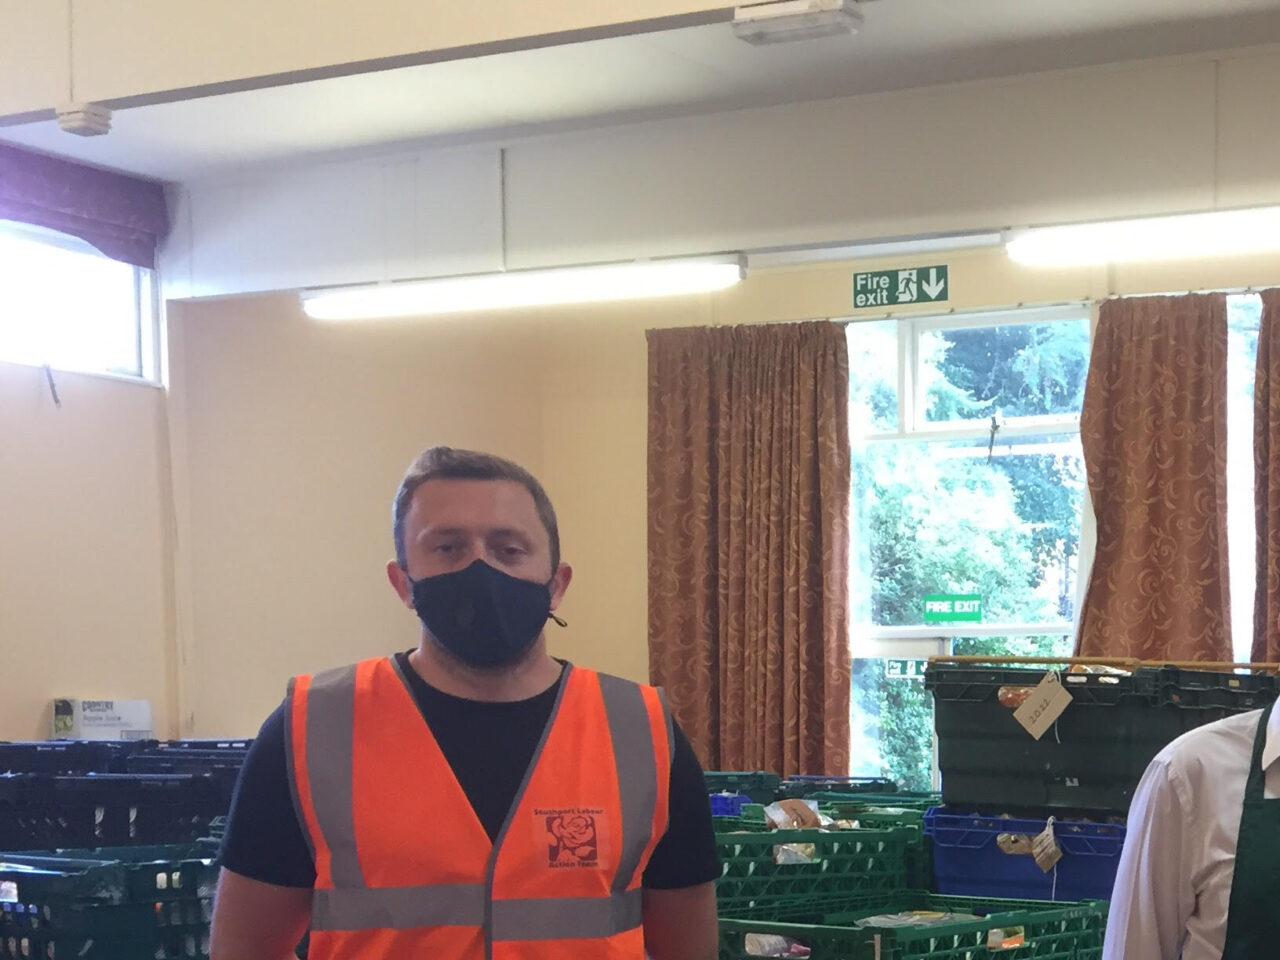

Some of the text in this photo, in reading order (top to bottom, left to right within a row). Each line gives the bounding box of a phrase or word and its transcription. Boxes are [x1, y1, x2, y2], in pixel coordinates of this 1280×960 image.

[856, 274, 890, 290] Fire
[856, 289, 888, 306] exit
[925, 600, 980, 613] FIRE EXIT
[534, 808, 575, 816] Southport
